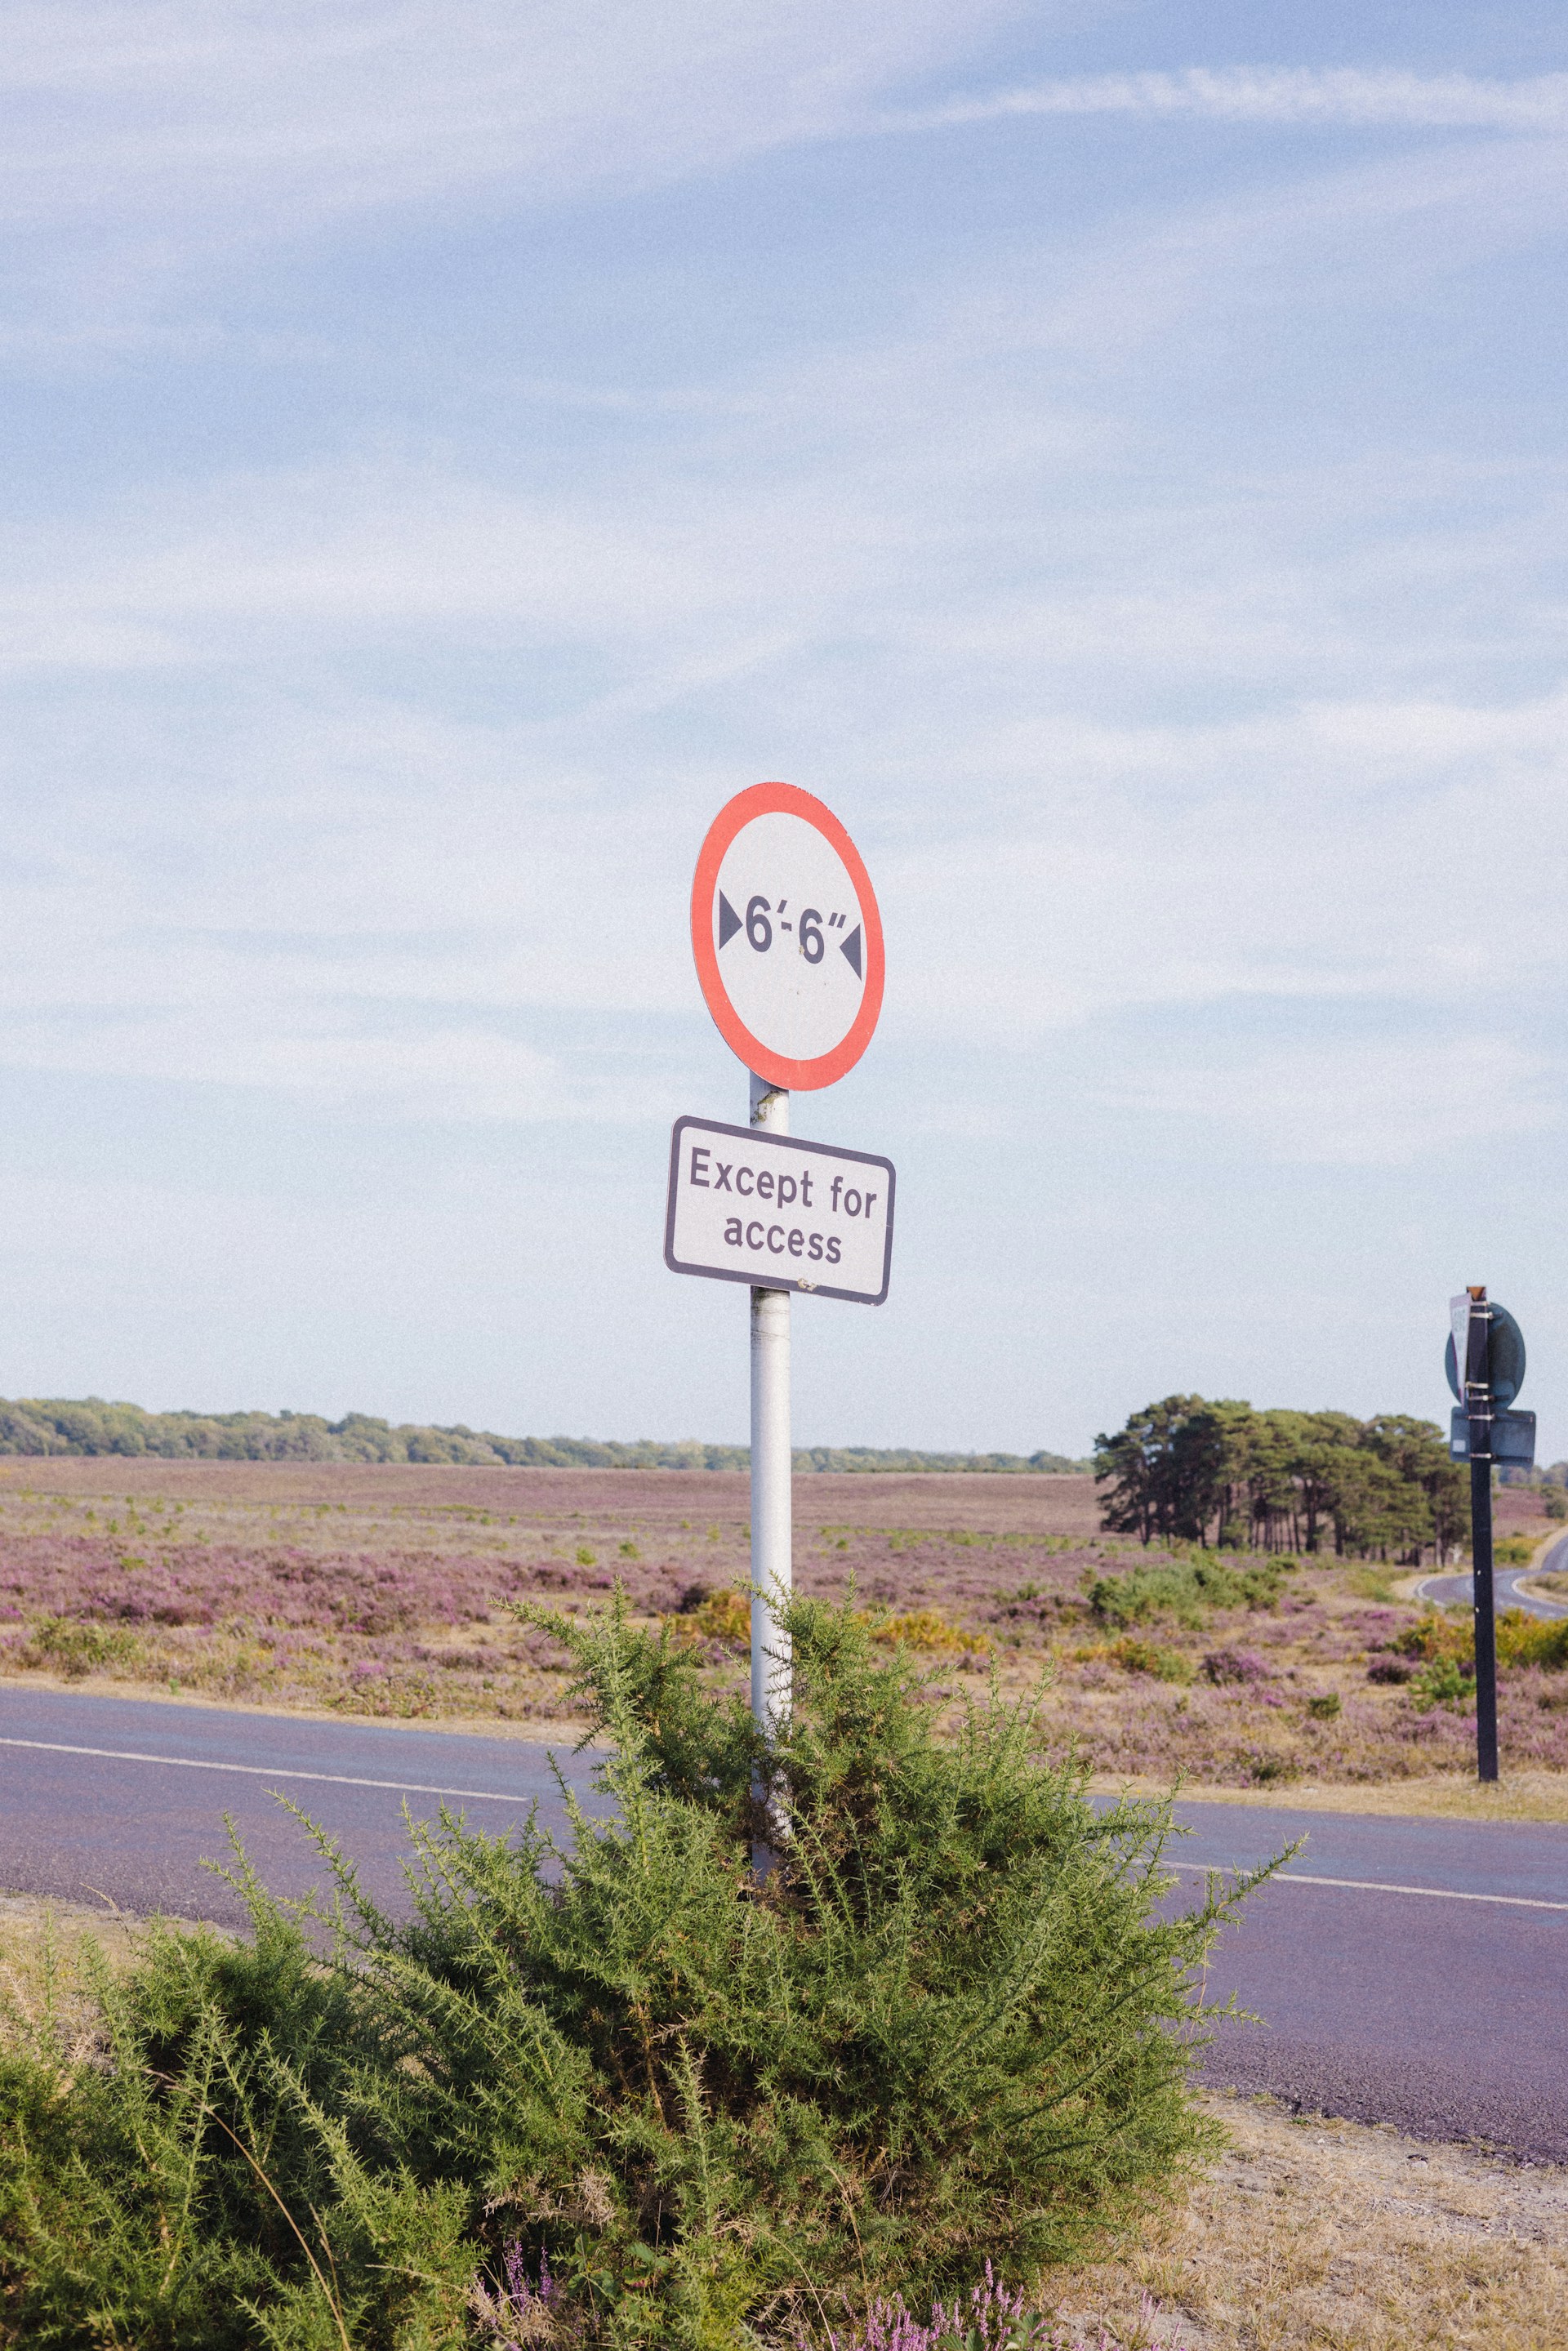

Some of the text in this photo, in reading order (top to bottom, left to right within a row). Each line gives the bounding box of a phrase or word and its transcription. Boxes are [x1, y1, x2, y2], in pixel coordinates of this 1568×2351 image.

[690, 1147, 877, 1218] Except for
[724, 1217, 842, 1264] access
